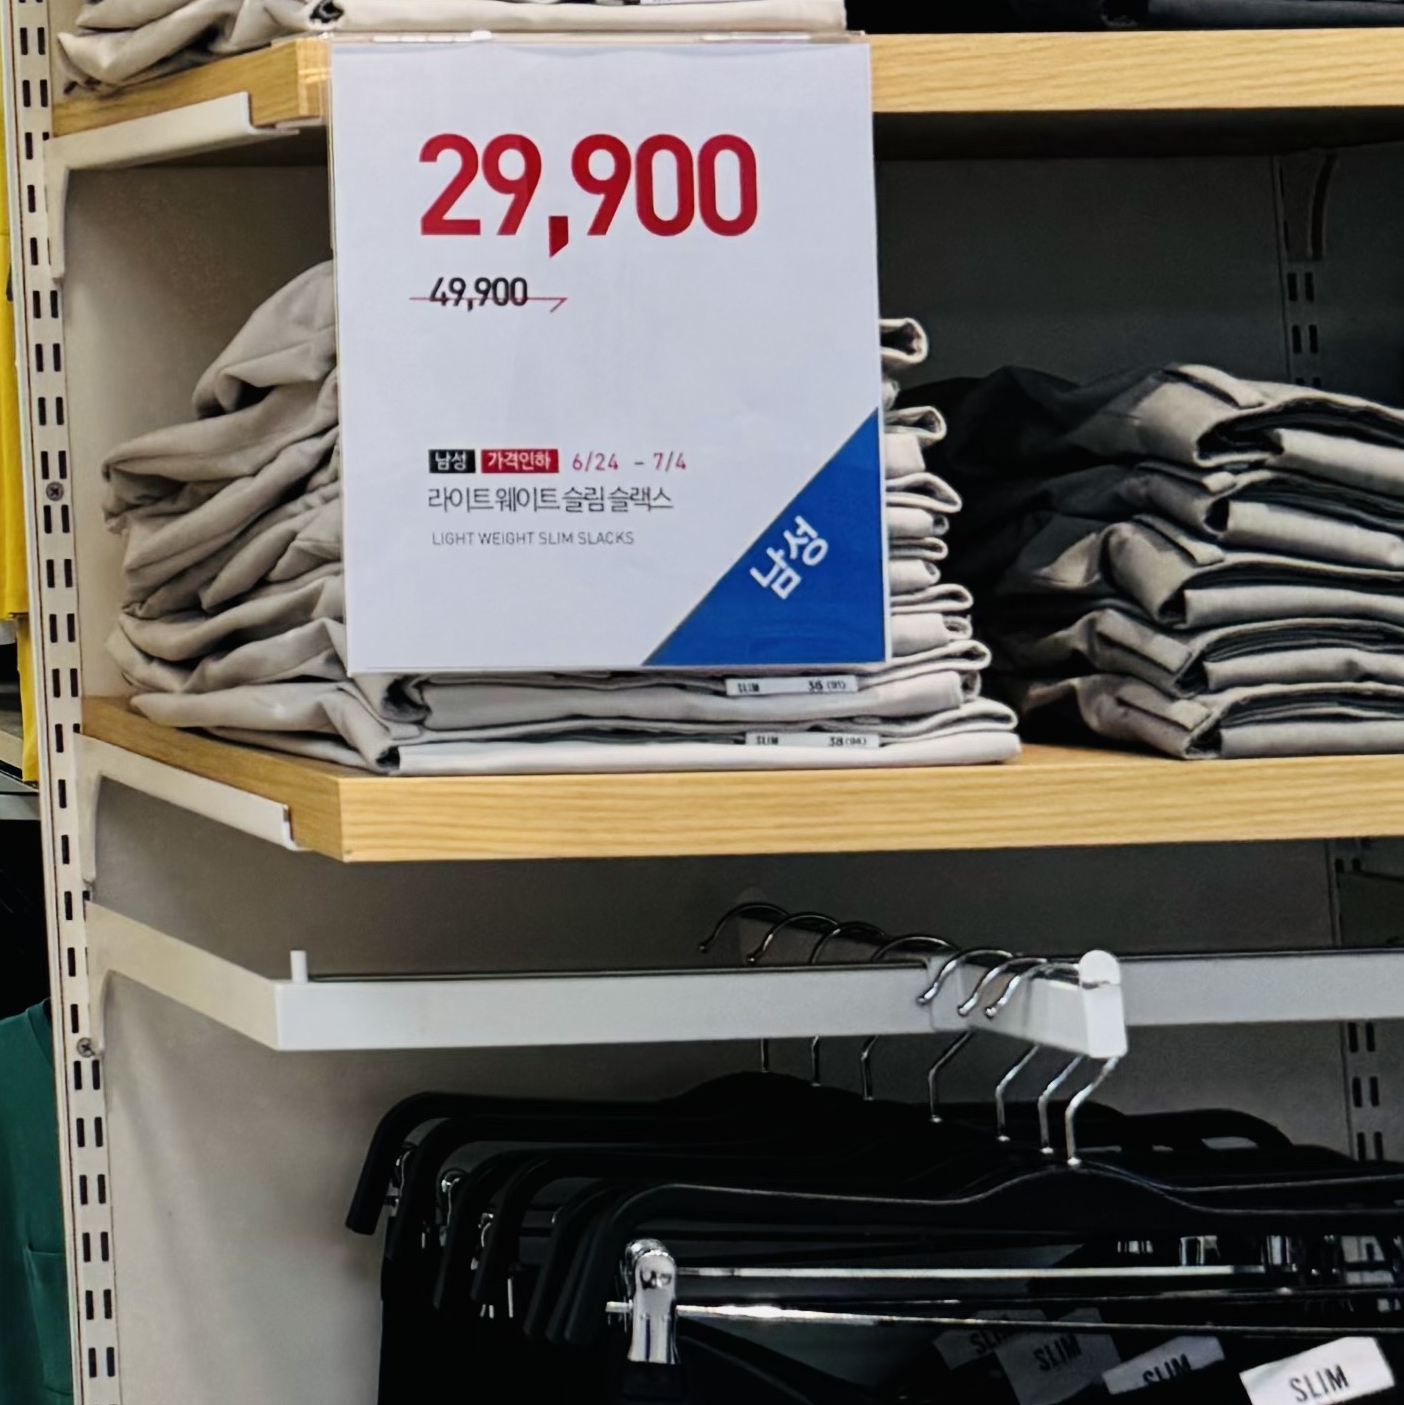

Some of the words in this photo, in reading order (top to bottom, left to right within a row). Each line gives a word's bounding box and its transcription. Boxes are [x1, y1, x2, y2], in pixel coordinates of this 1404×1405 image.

[419, 133, 759, 258] 29,900
[428, 277, 529, 313] 49,900
[434, 452, 467, 471] 남성
[487, 452, 551, 471] 가격인하
[571, 452, 620, 472] 6/24
[653, 451, 687, 472] 7/4
[562, 487, 605, 513] 슬림
[607, 486, 675, 513] 슬랙스
[432, 531, 475, 546] LIGHT
[477, 531, 535, 546] WEIGHT
[538, 531, 574, 545] SLIM
[577, 530, 635, 545] SLACKS
[749, 515, 829, 600] 남성
[737, 682, 760, 693] SLIM
[756, 735, 779, 744] SLIM
[1033, 1334, 1083, 1372] SLIM
[1289, 1364, 1351, 1403] SLIM
